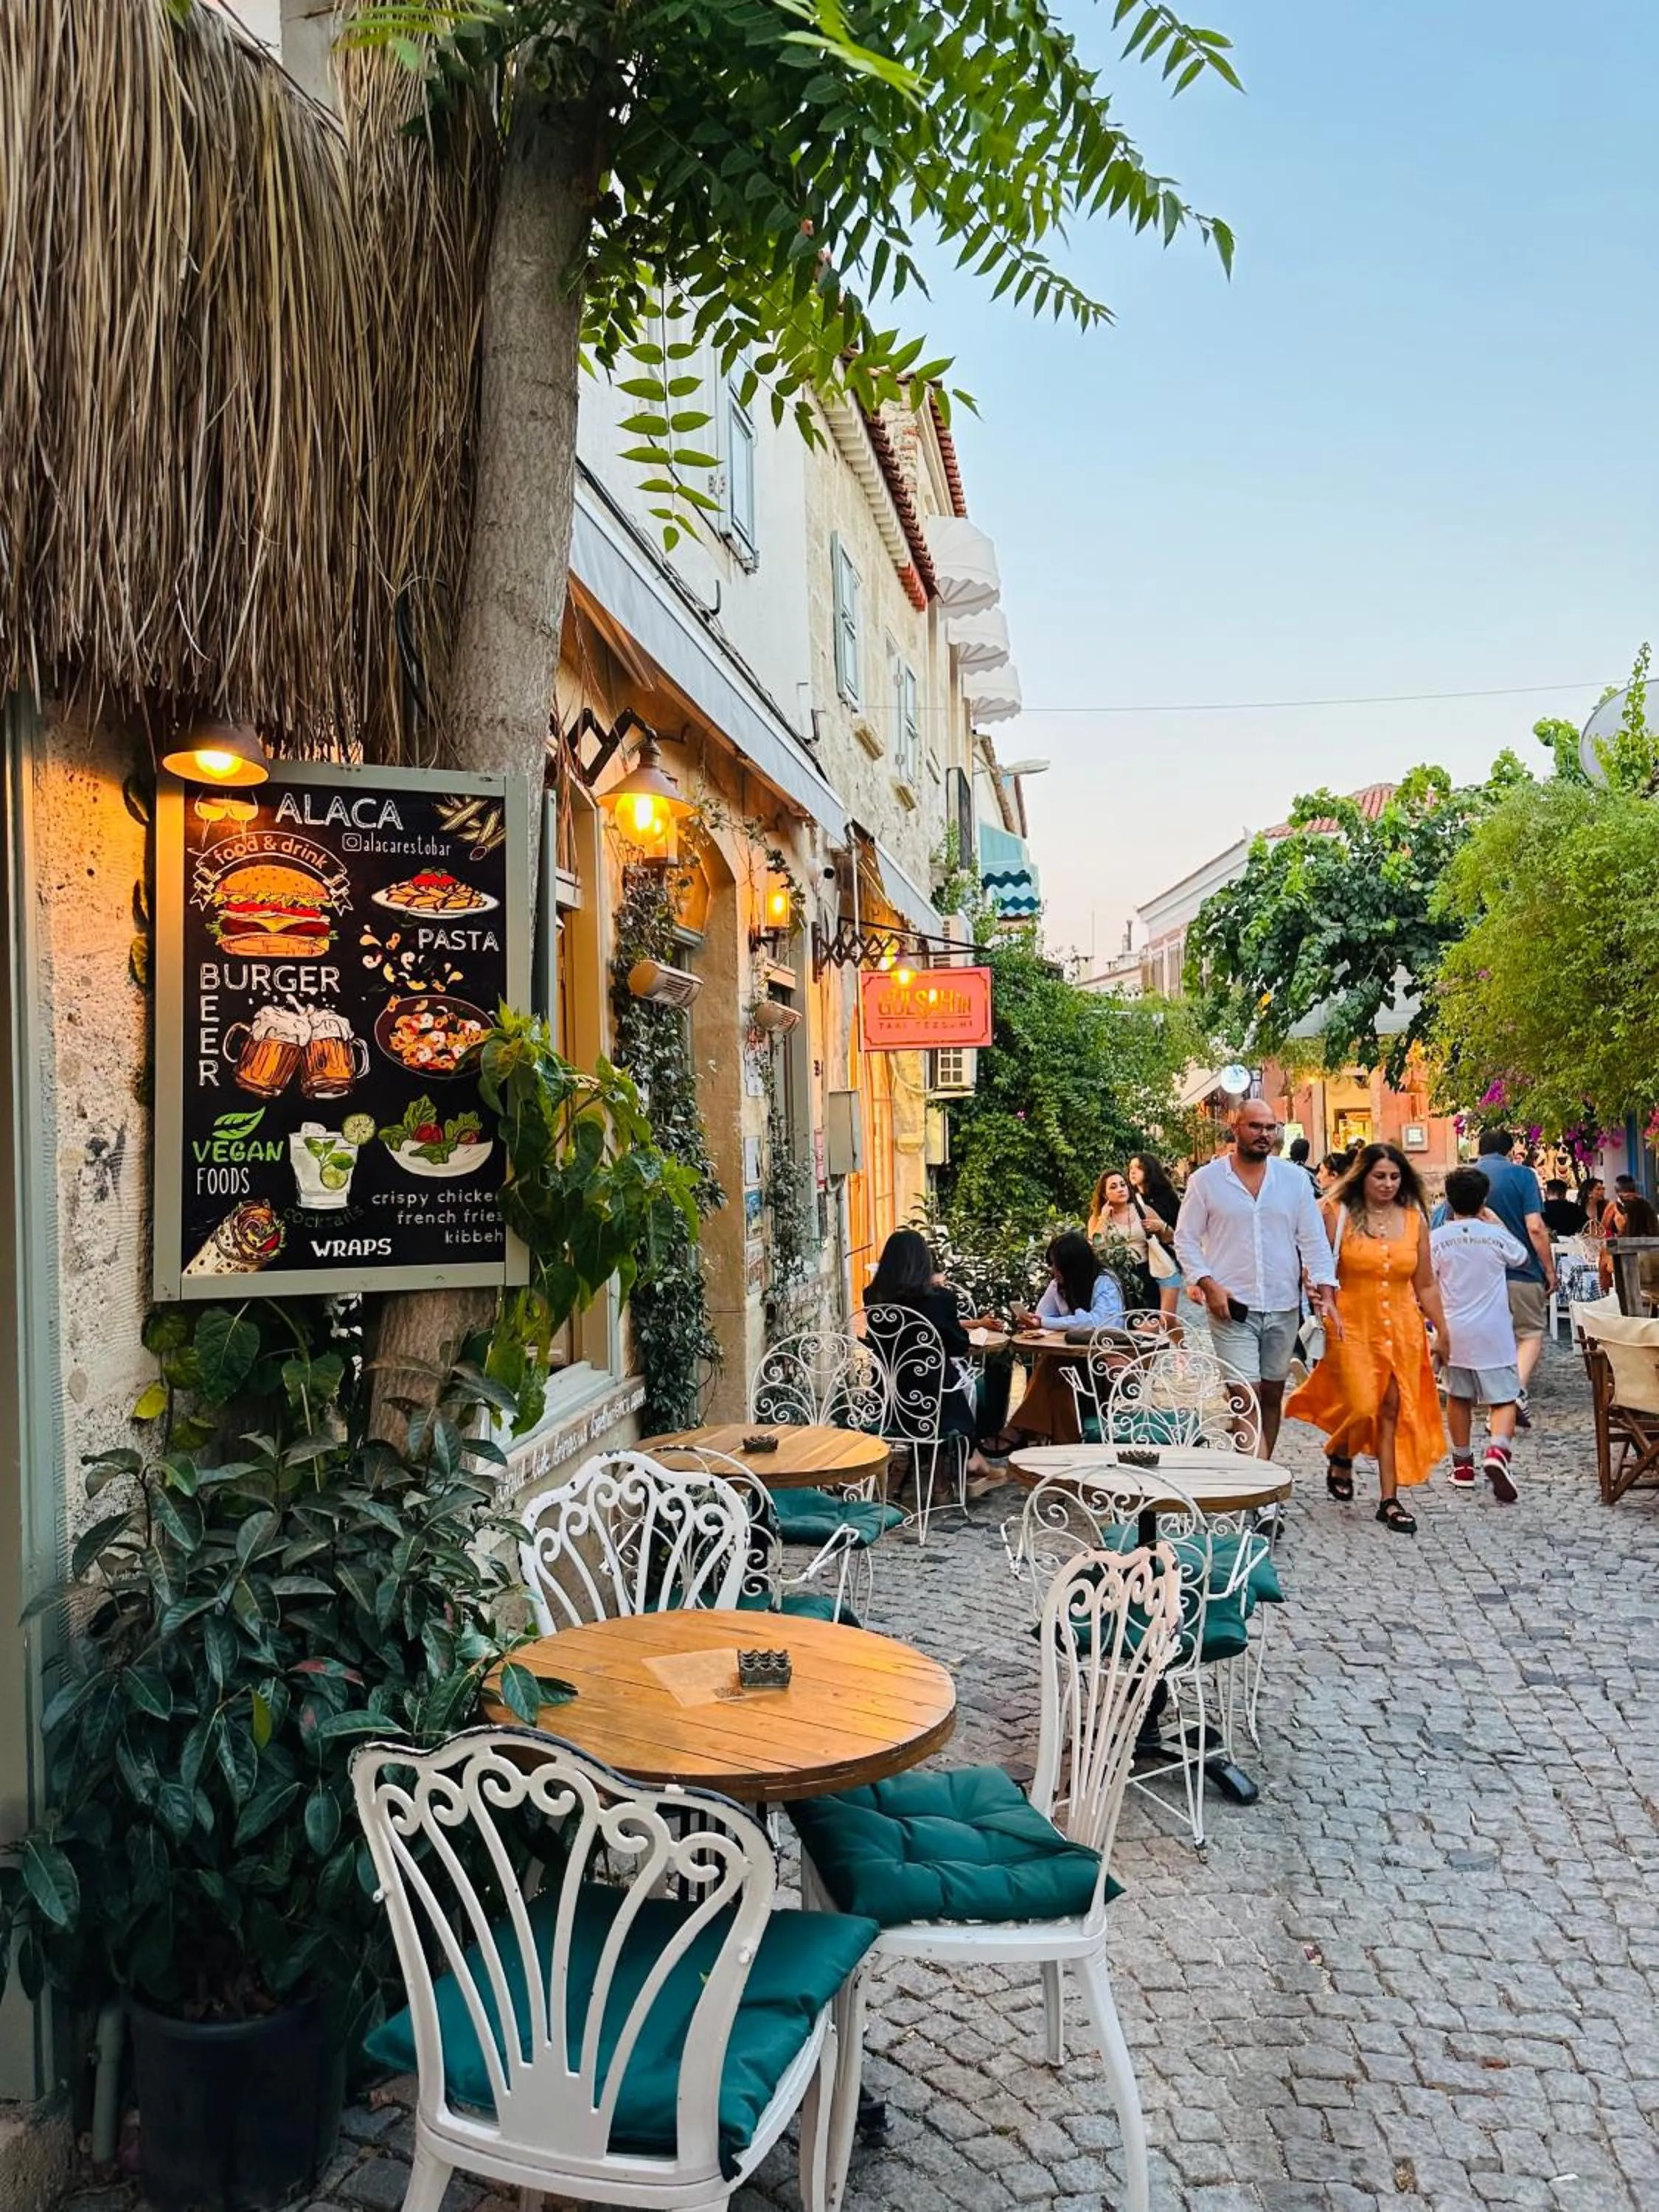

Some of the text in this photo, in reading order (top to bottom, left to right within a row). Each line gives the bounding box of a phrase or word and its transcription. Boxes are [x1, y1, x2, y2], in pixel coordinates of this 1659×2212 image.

[275, 793, 404, 830] ALACA
[213, 835, 328, 869] food & drink
[418, 929, 499, 952] PASTA
[200, 964, 341, 992] BURGER
[192, 1140, 284, 1163] VEGAN
[197, 1168, 250, 1194] FOODS
[372, 1193, 429, 1205] crispy
[397, 1209, 457, 1225] french
[310, 1238, 392, 1257] WRAPS
[445, 1229, 503, 1244] kibbeh
